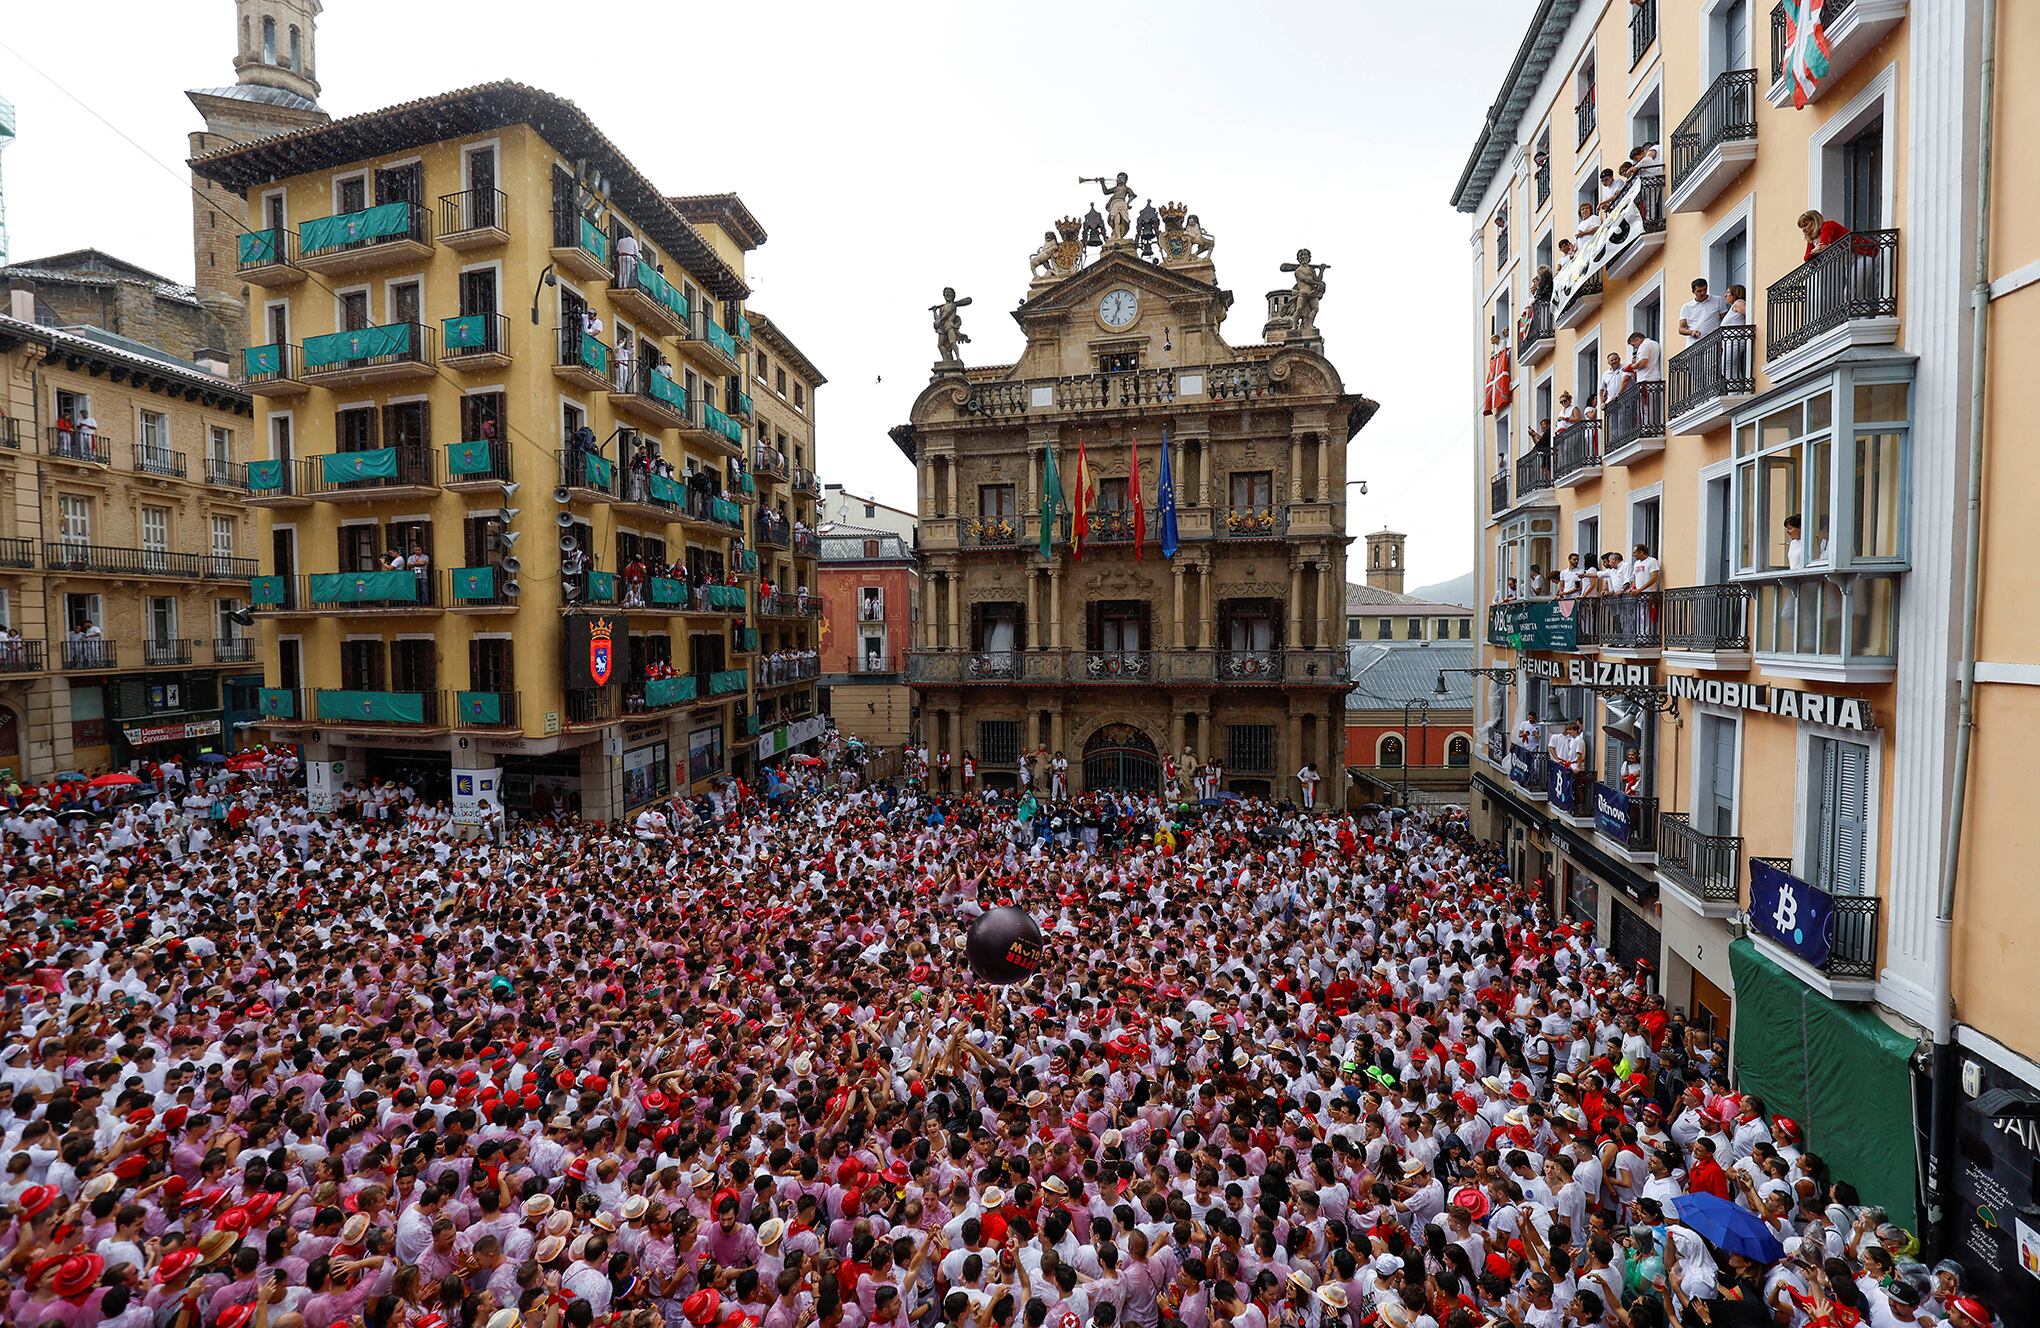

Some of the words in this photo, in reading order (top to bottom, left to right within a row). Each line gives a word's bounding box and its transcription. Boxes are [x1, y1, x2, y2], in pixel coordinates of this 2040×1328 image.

[1516, 657, 1560, 678] AGENCIA
[1569, 659, 1650, 686] ELIZARI
[1667, 675, 1863, 731] INMOBILIARIA
[142, 728, 165, 736] Licores
[142, 734, 169, 742] Cervezas
[1697, 945, 1703, 960] 2
